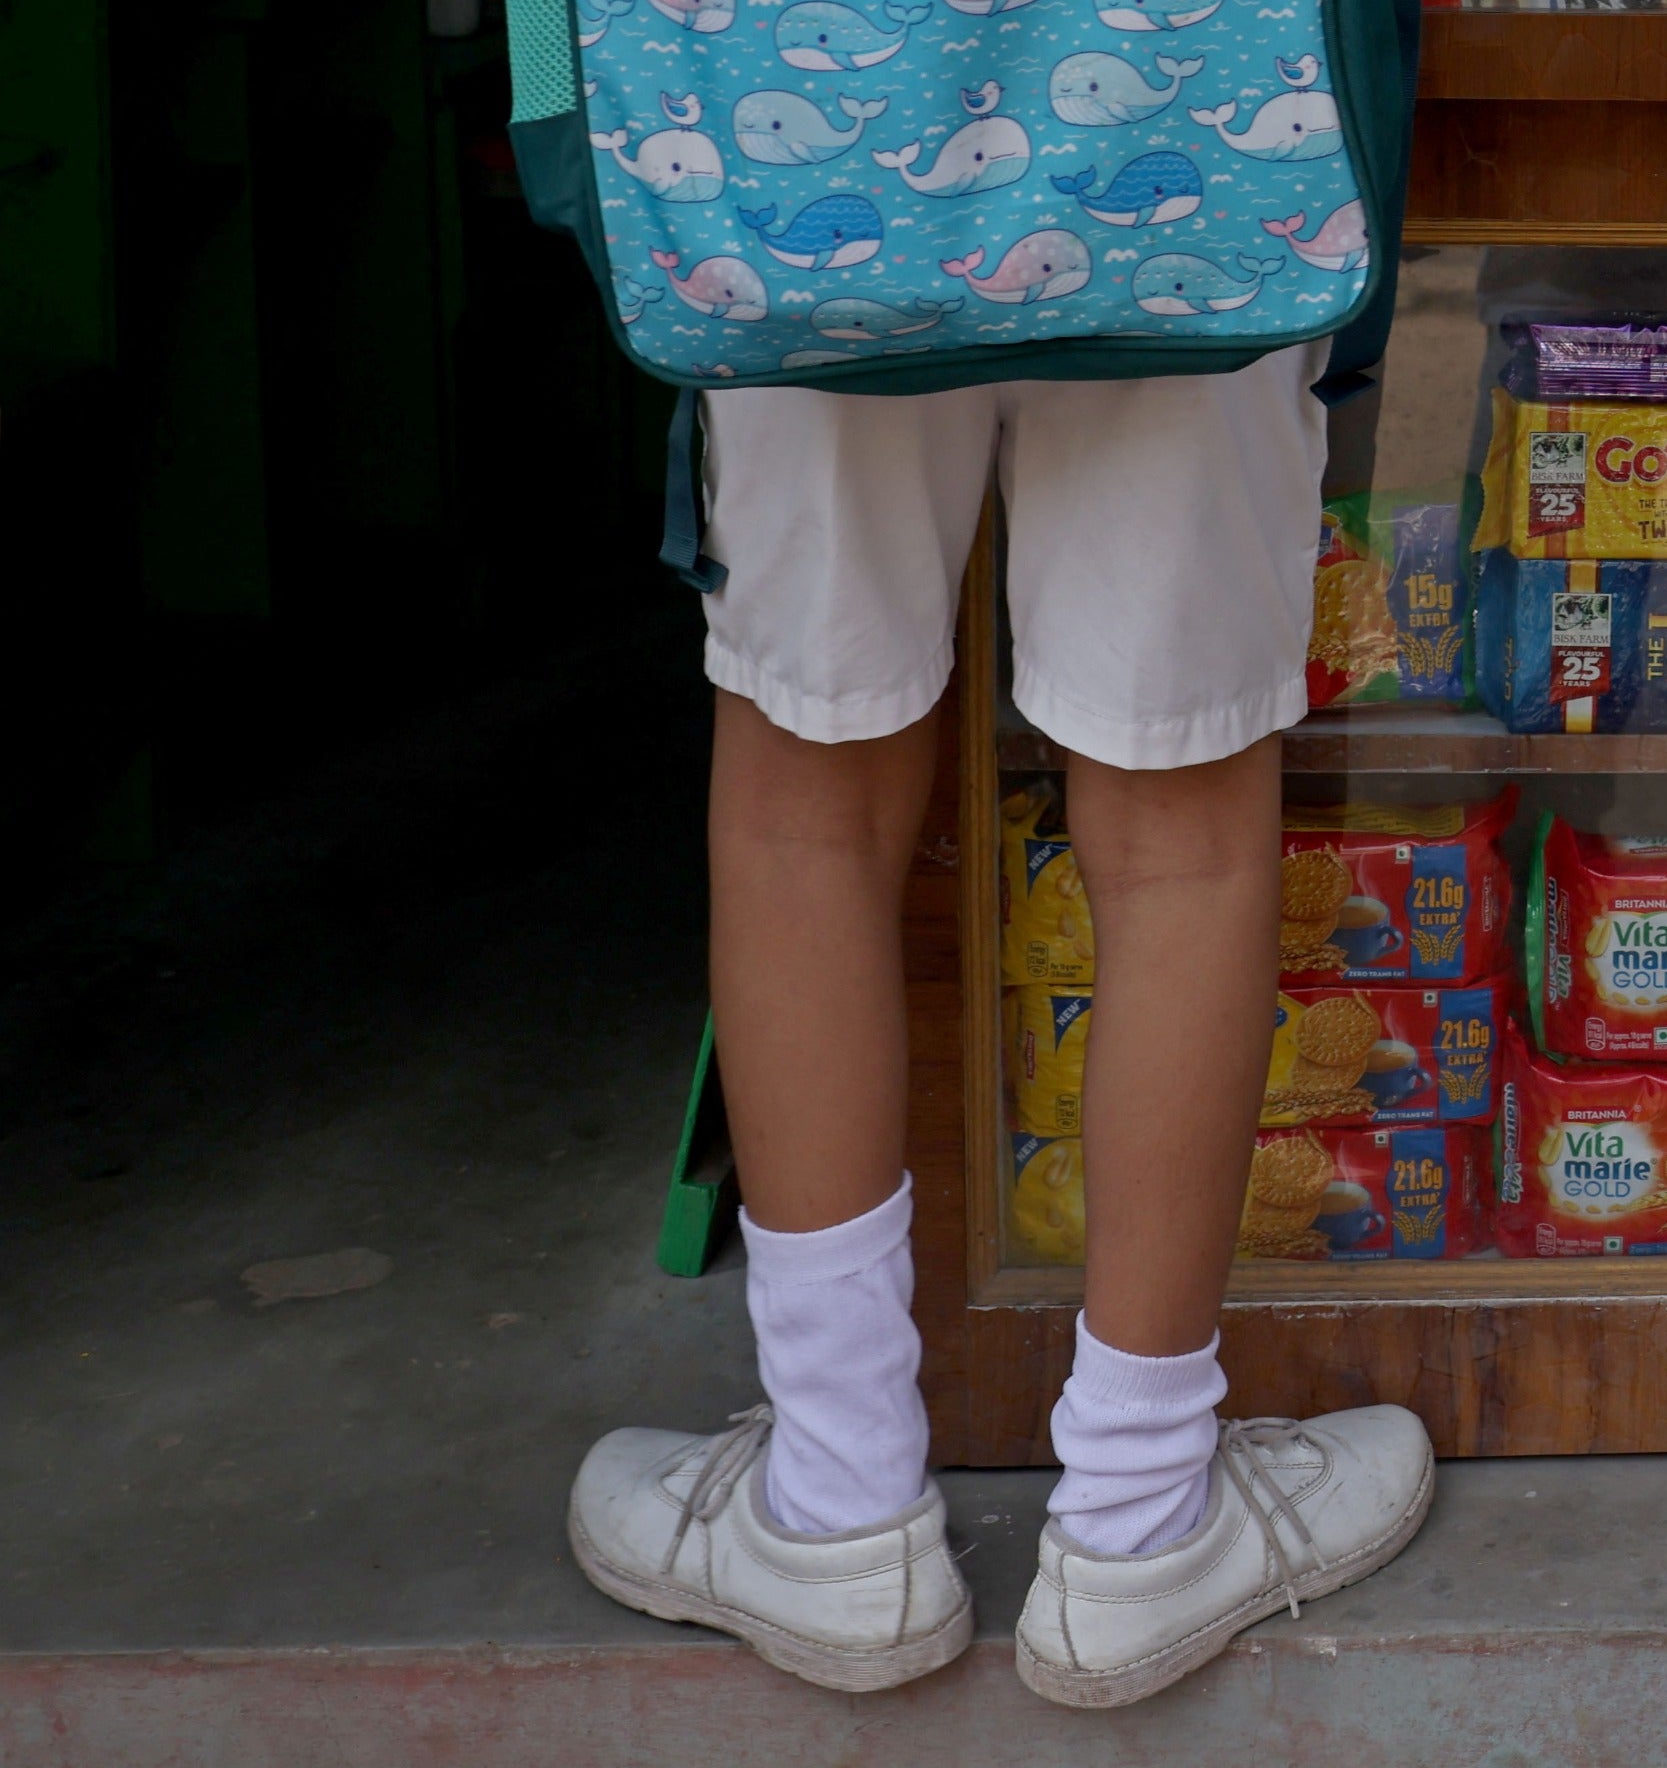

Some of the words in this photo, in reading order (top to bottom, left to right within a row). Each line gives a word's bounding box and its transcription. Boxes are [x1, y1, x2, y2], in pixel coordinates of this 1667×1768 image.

[1532, 472, 1554, 481] BISK
[1557, 472, 1584, 481] FARM
[1540, 494, 1577, 516] 25
[1404, 574, 1453, 610] 15g
[1553, 634, 1575, 644] BISK
[1577, 634, 1610, 644] FARM
[1562, 657, 1601, 680] 25
[1647, 636, 1664, 681] THE
[1029, 846, 1052, 871] NEW
[1413, 878, 1465, 911] 21.6g
[1419, 913, 1457, 926] EXTRA
[1056, 1003, 1080, 1027] NEW
[1441, 1020, 1490, 1053] 21.6g
[1448, 1052, 1485, 1066] EXTRA
[1567, 1110, 1628, 1120] BRITANNIA
[1565, 1131, 1623, 1159] Vita
[1393, 1159, 1443, 1192] 21.6g
[1564, 1181, 1631, 1198] GOLD
